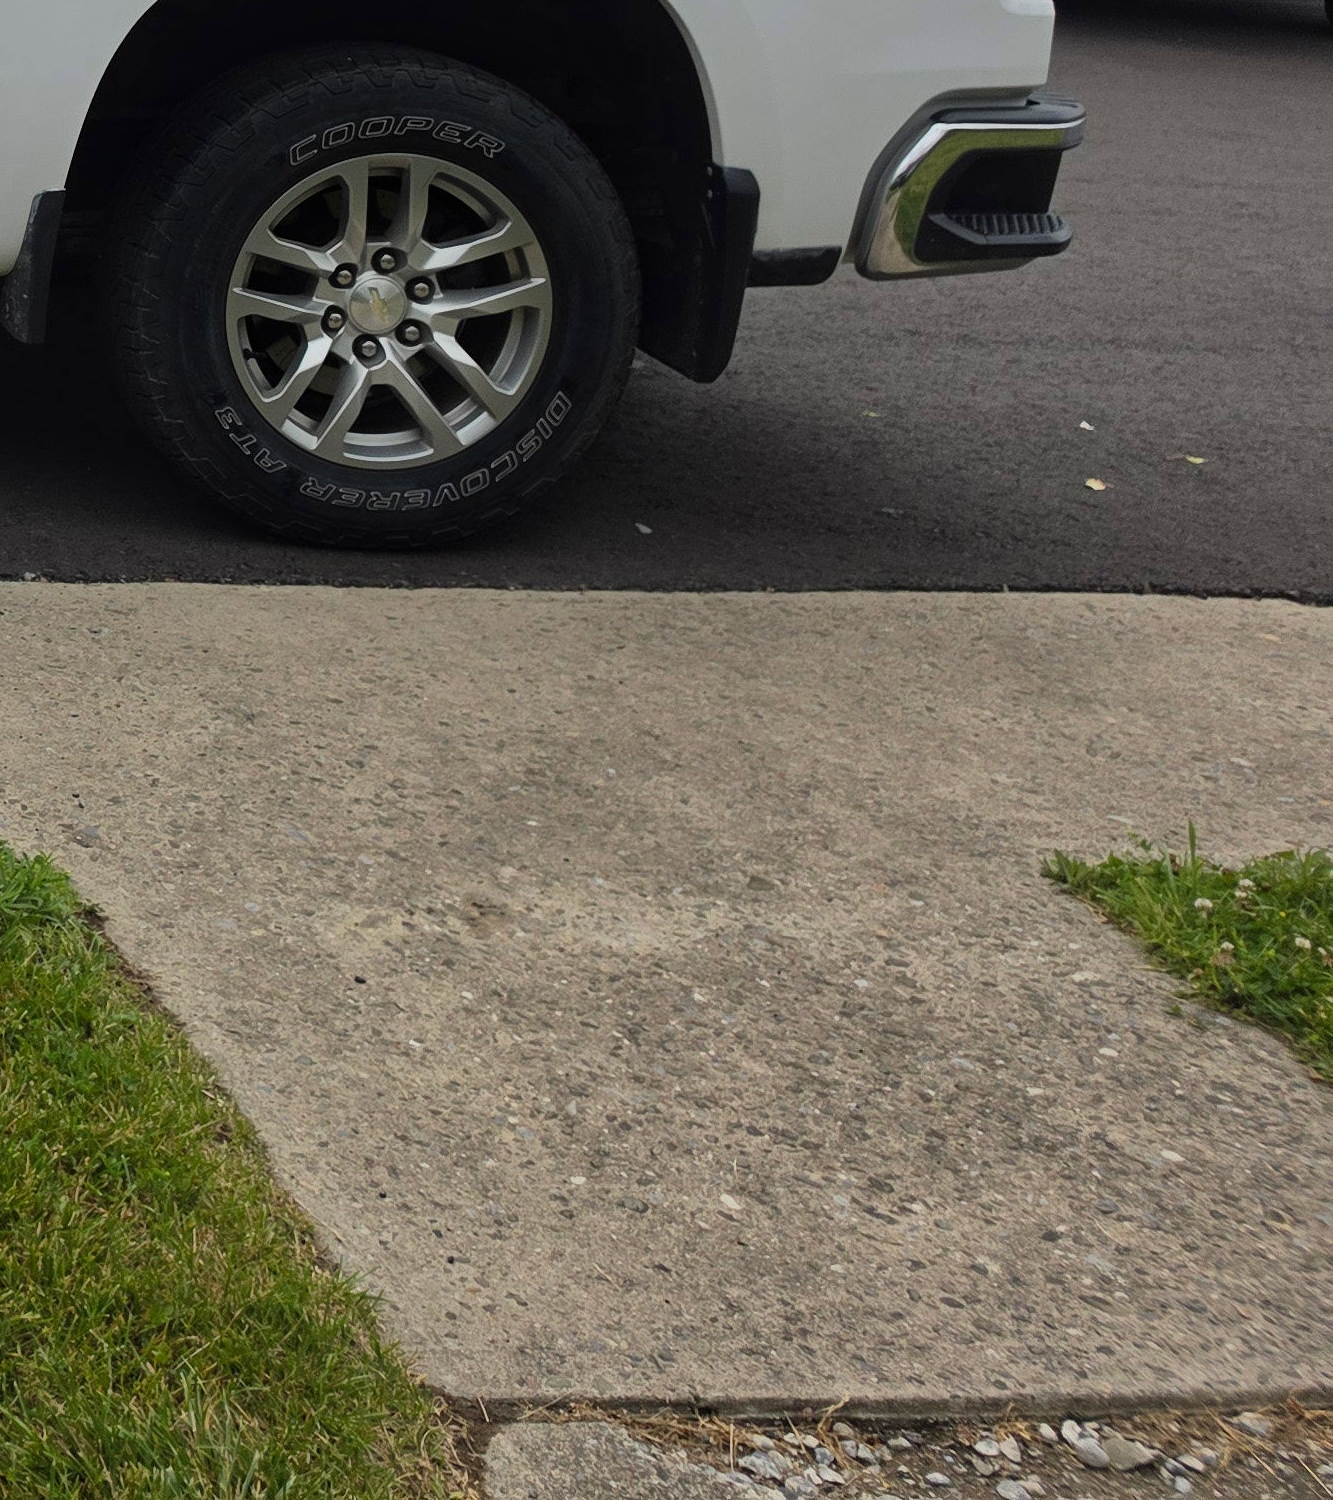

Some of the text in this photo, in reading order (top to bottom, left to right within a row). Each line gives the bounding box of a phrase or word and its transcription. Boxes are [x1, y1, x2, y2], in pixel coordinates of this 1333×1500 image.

[289, 115, 506, 166] COOPER
[214, 390, 572, 512] DISCOVERER AT3
